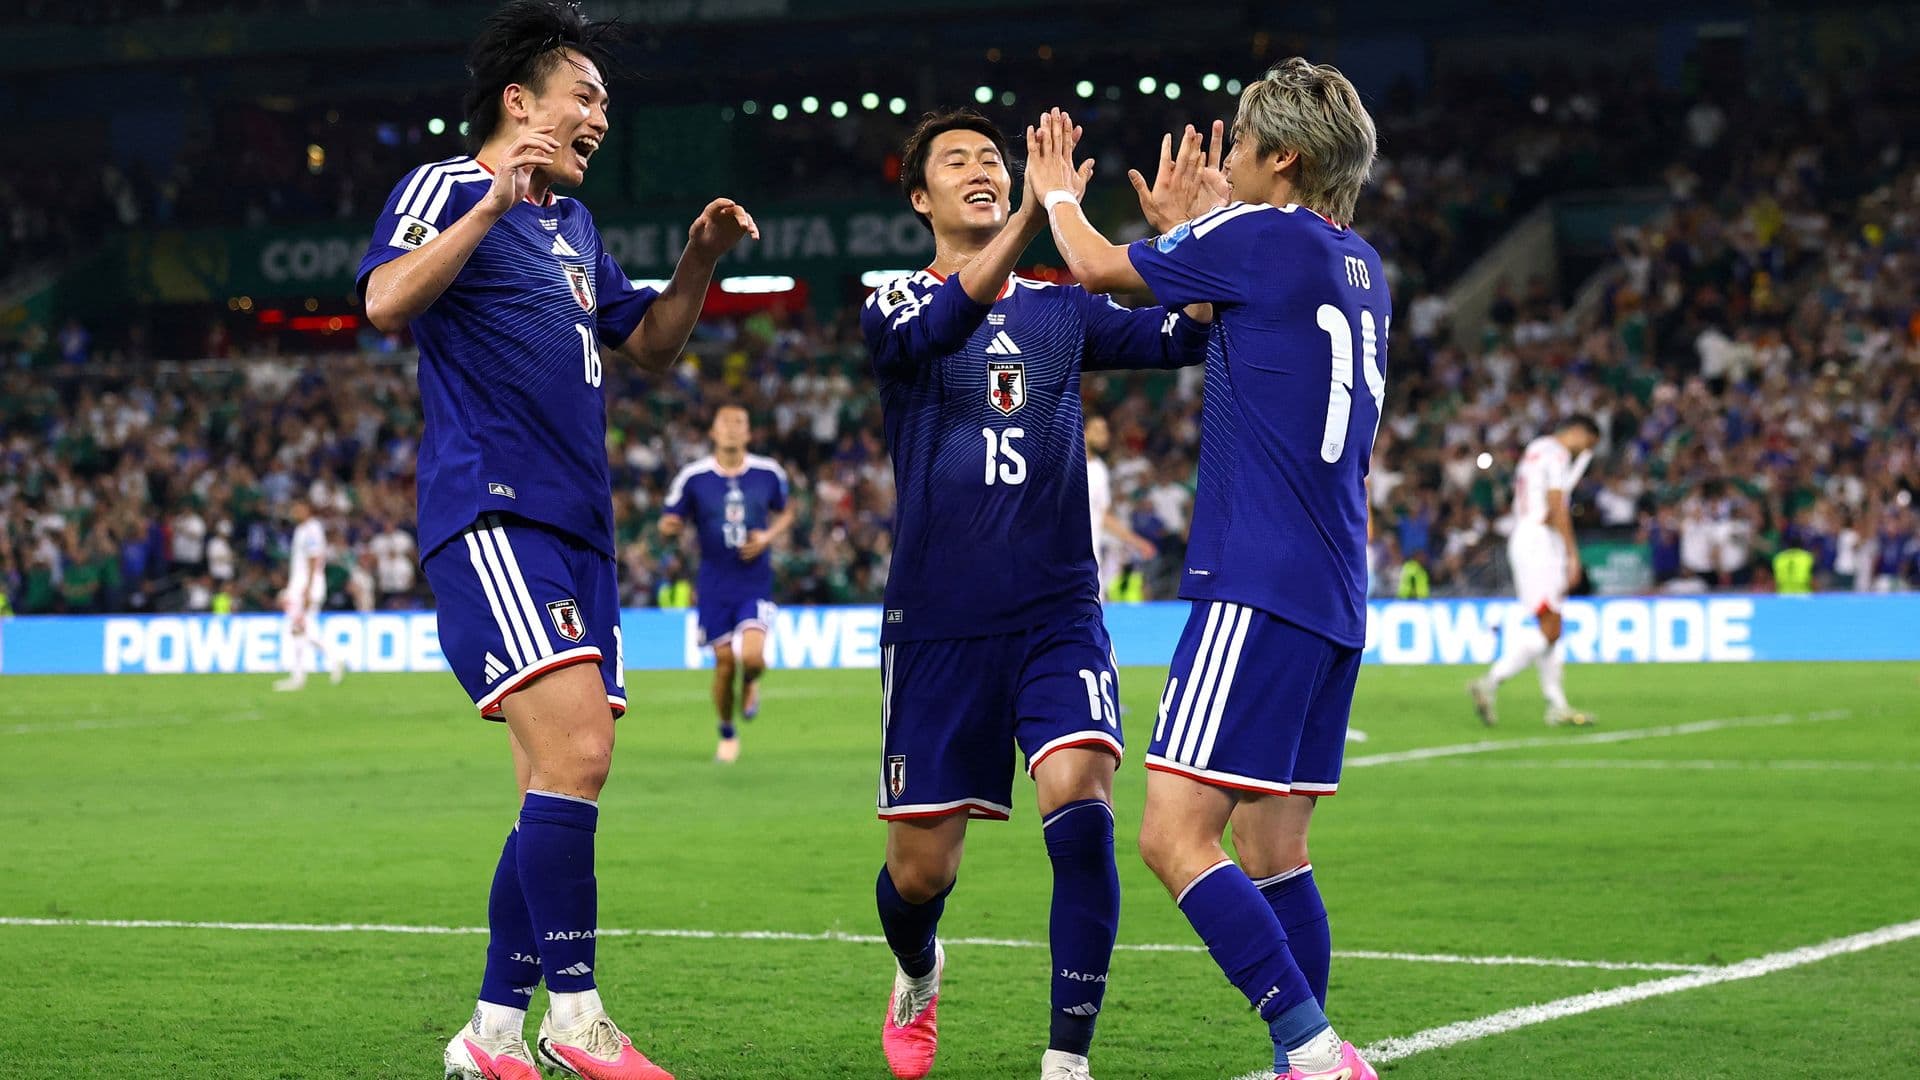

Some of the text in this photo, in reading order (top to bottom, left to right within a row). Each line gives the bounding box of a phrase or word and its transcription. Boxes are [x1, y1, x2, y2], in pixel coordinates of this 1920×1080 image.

[1344, 255, 1371, 290] ITO
[982, 427, 1026, 485] 15
[1079, 669, 1117, 730] 15
[1060, 969, 1107, 982] JAPA
